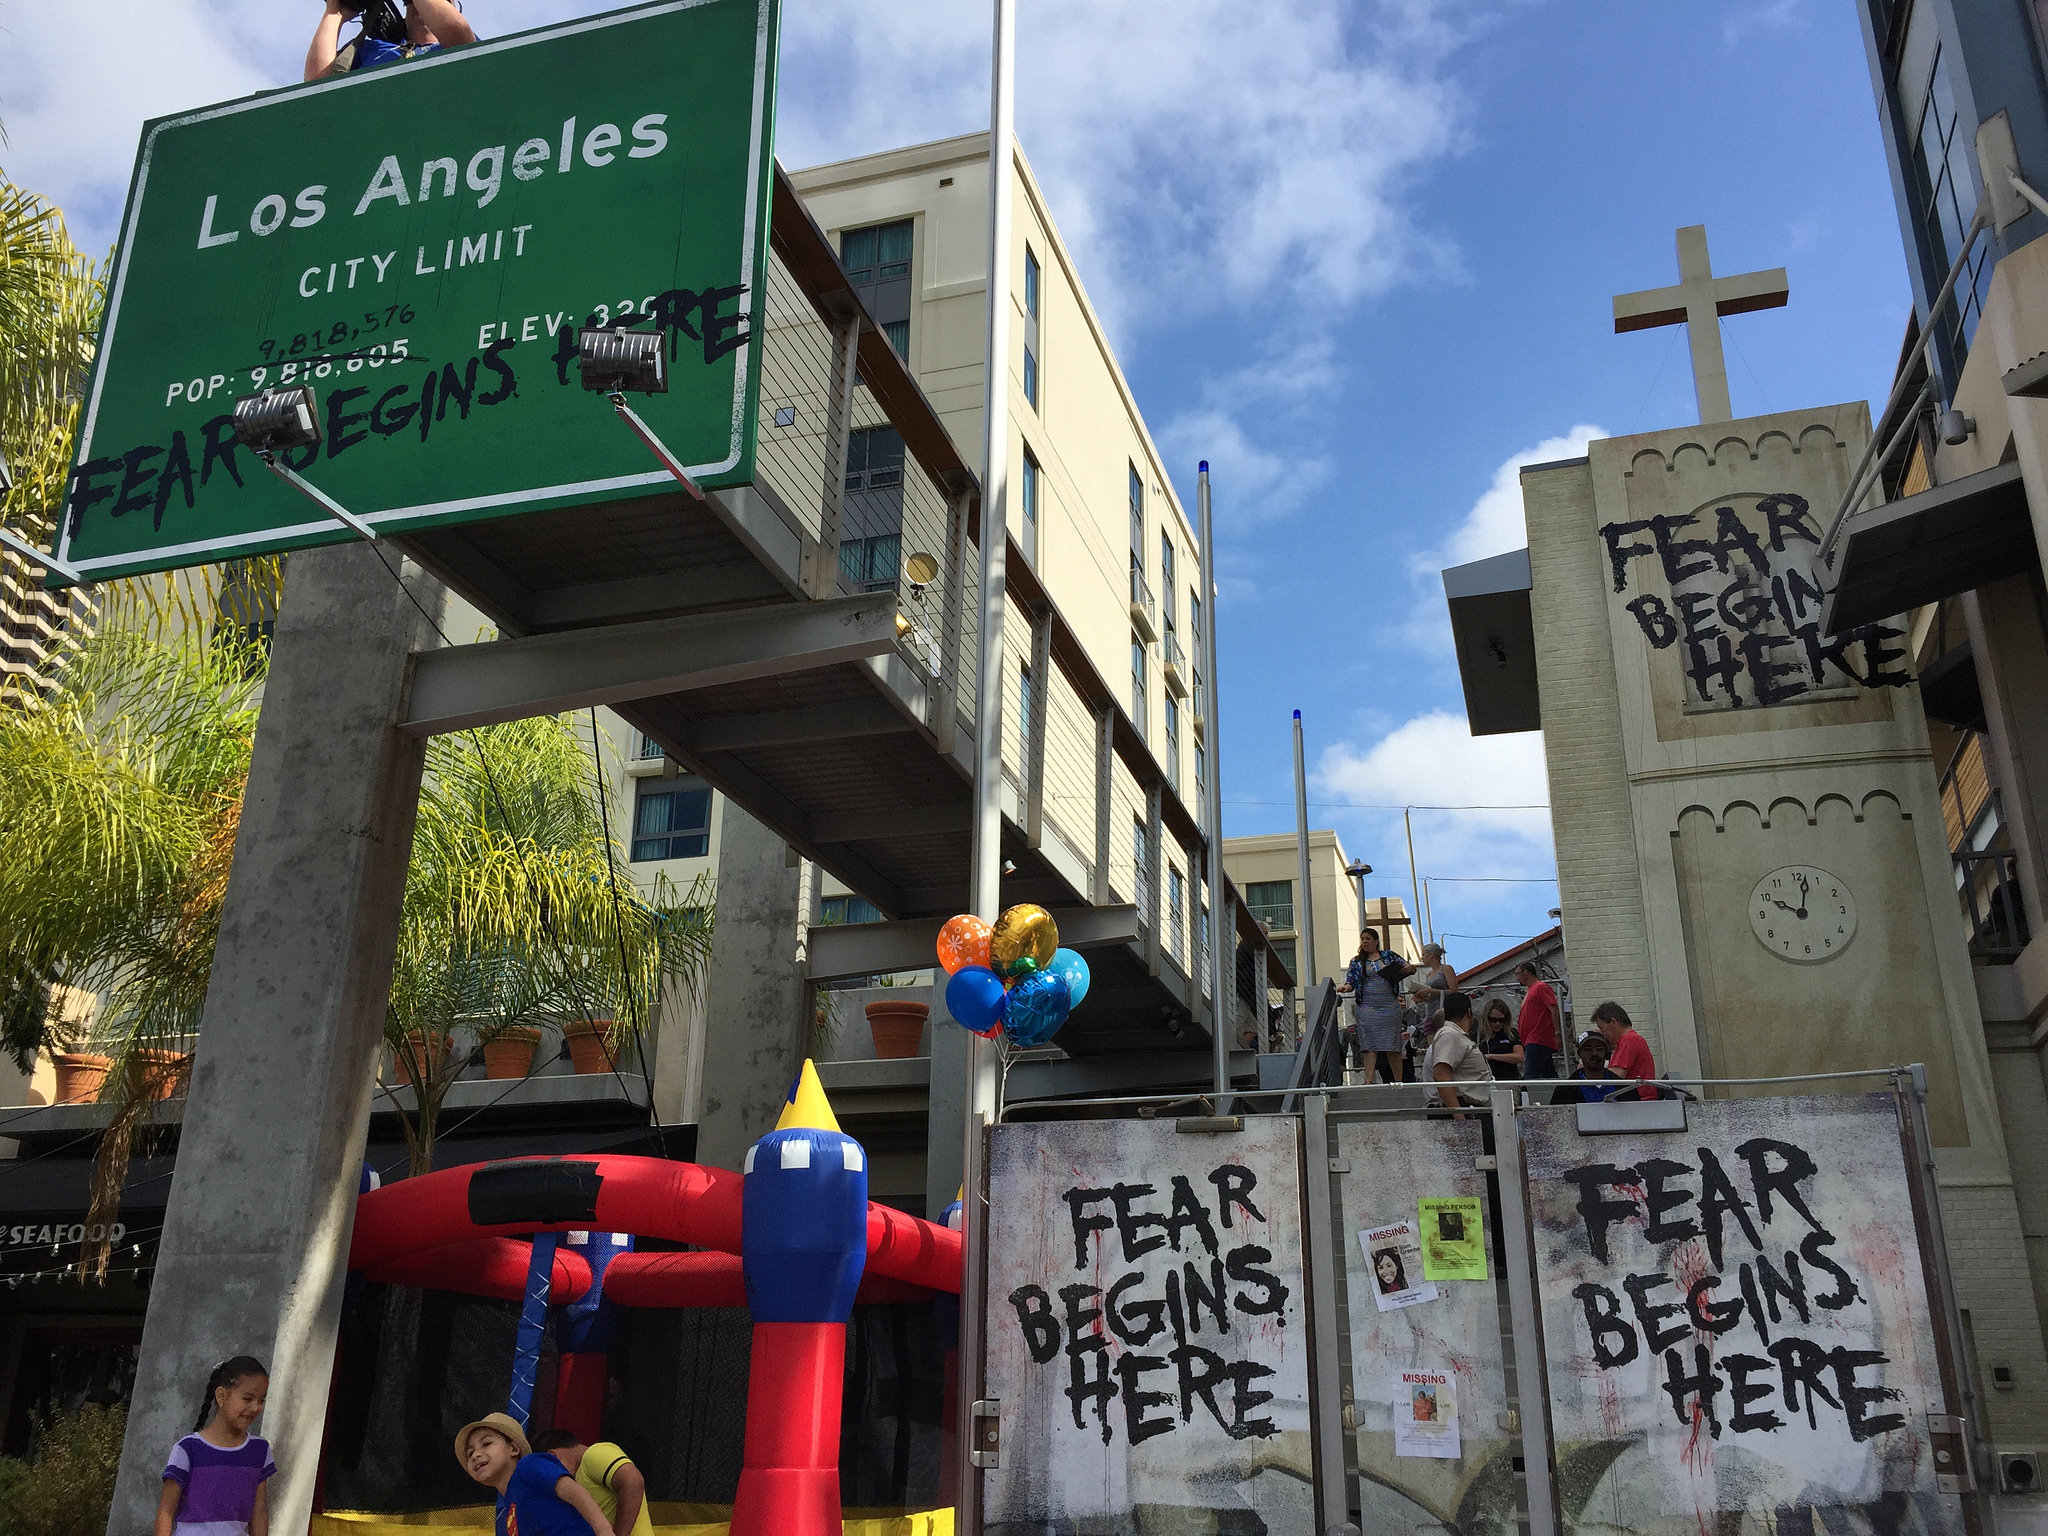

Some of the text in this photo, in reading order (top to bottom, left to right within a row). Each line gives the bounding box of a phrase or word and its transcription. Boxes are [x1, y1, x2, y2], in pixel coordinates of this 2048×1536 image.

[197, 113, 668, 249] Los Angeles
[299, 224, 532, 298] CITY LIMIT
[259, 303, 415, 360] 9,818,576
[166, 374, 235, 407] POP:
[67, 414, 245, 542] FEAR
[551, 284, 758, 386] HRE
[1600, 493, 1821, 593] FEAR
[1626, 568, 1825, 649] BEGIN
[1686, 622, 1918, 708] HERE
[1772, 879, 1782, 888] 11
[1792, 873, 1802, 881] 12
[1760, 893, 1771, 902] 10
[1831, 889, 1838, 898] 2
[1759, 910, 1766, 919] 9
[1840, 906, 1846, 914] 3
[1767, 929, 1774, 938] 8
[1837, 925, 1844, 934] 4
[1784, 941, 1789, 950] 7
[1804, 945, 1811, 954] 6
[1825, 939, 1831, 948] 5
[1062, 1164, 1266, 1270] FEAR
[1563, 1138, 1821, 1273] FEAR
[9, 1223, 126, 1245] SEAFOOD
[1368, 1225, 1410, 1242] MISSING
[1008, 1244, 1289, 1364] BEGINS
[1572, 1230, 1867, 1370] BEGINS
[1402, 1374, 1447, 1384] MISSING
[1662, 1337, 1906, 1442] HERE
[1064, 1344, 1282, 1446] HERE
